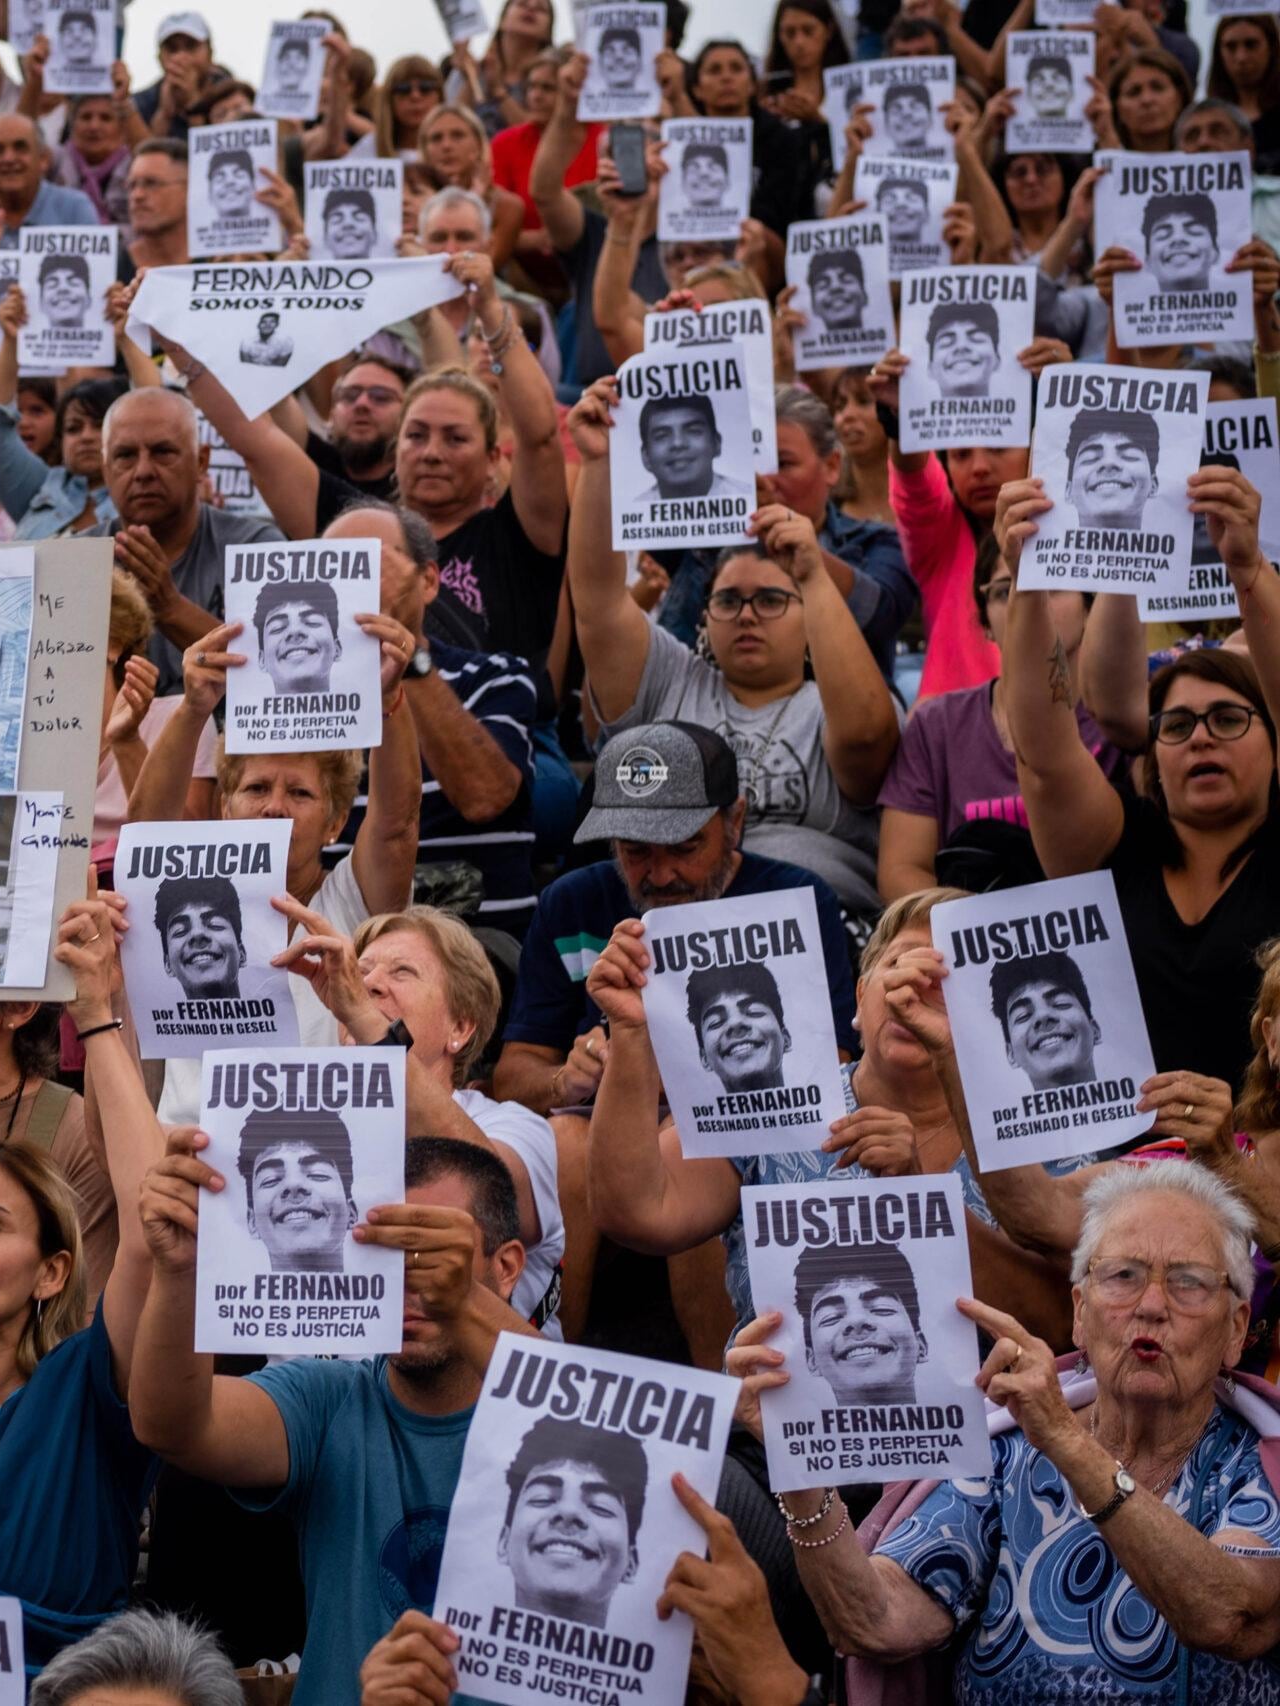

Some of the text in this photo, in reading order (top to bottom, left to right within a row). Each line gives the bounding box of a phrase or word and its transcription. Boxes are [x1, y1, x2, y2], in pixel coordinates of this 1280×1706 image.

[194, 129, 272, 153] JUSTICIA
[310, 166, 395, 189] JUSTICIA
[1121, 161, 1244, 195] JUSTICIA
[25, 232, 111, 254] JUSTICIA
[792, 224, 883, 253] JUSTICIA
[191, 267, 374, 293] FERNANDO
[909, 277, 1027, 304] JUSTICIA
[190, 297, 365, 311] SOMOS TODOS
[1149, 293, 1237, 312] FERNANDO
[651, 311, 765, 342] JUSTICIA
[1045, 374, 1197, 414] JUSTICIA
[930, 399, 1016, 416] FERNANDO
[622, 498, 746, 525] por FERNANDO
[623, 521, 747, 540] ASESINADO EN GESELL
[1036, 529, 1175, 555] por FERNANDO
[231, 550, 371, 583] JUSTICIA
[39, 594, 65, 617] ME
[1148, 593, 1236, 611] ASESINADO EN
[44, 666, 55, 680] A
[235, 693, 360, 717] por FERNANDO
[127, 843, 271, 879] JUSTICIA
[651, 918, 806, 974] JUSTICIA
[951, 904, 1110, 968] JUSTICIA
[152, 998, 275, 1021] por FERNANDO
[156, 1021, 277, 1035] ASESINADO EN GESELL
[207, 1063, 394, 1109] JUSTICIA
[692, 1085, 821, 1118] por FERNANDO
[993, 1077, 1136, 1124] por FERNANDO
[697, 1109, 822, 1133] ASESINADO EN GESELL
[997, 1104, 1136, 1140] ASESINADO EN GESELL
[755, 1191, 955, 1247] JUSTICIA
[215, 1274, 385, 1301] por FERNANDO
[218, 1305, 380, 1319] SI NO ES PERPETUA
[233, 1323, 365, 1337] NO ES JUSTICIA
[490, 1349, 716, 1451] JUSTICIA
[782, 1405, 964, 1438] por FERNANDO
[789, 1434, 963, 1455] SI NO ES PERPETUA
[807, 1450, 949, 1472] NO ES JUSTICIA
[445, 1606, 654, 1673] por FERNANDO
